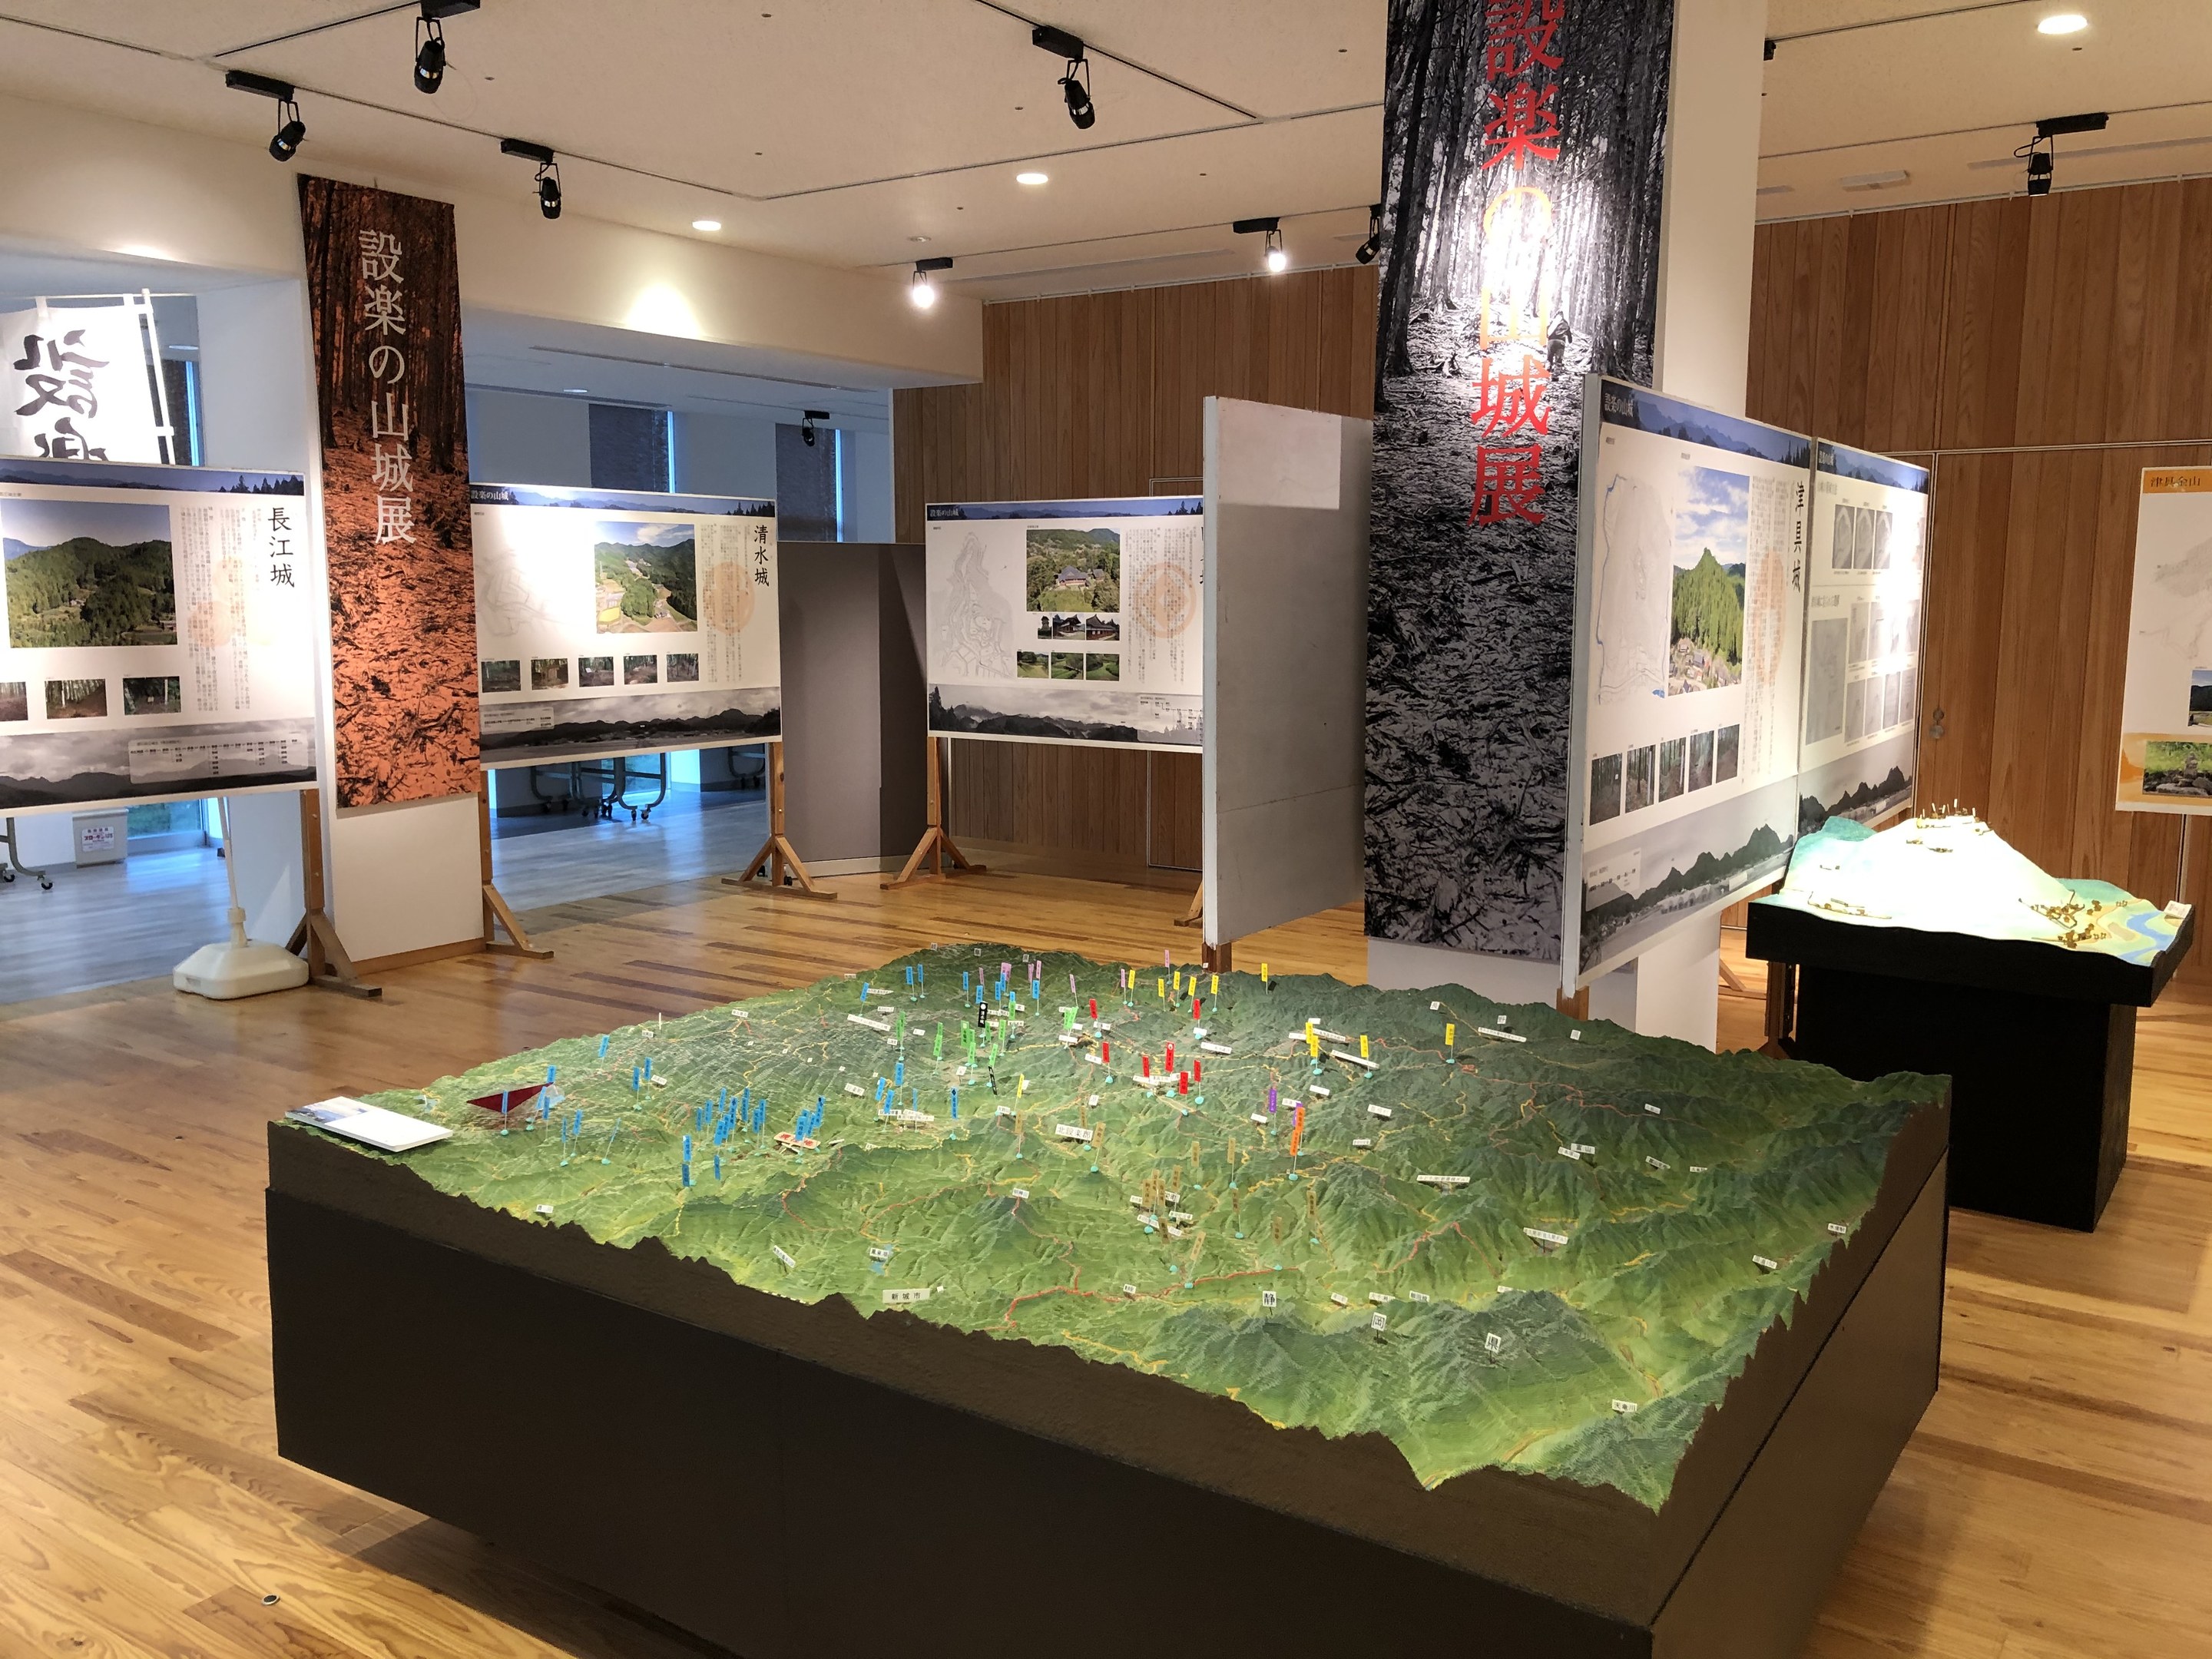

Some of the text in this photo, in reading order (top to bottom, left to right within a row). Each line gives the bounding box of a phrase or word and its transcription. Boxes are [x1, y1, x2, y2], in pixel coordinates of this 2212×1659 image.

[359, 229, 416, 545] 設楽の山城展
[1604, 392, 1634, 417] 設楽の山城
[471, 490, 508, 501] 設楽の山城
[267, 507, 296, 588] 長江城
[754, 524, 770, 587] 清水城
[1792, 480, 1805, 593] 津具城
[1057, 1126, 1091, 1140] 北設楽郡
[891, 1292, 922, 1301] 新城市
